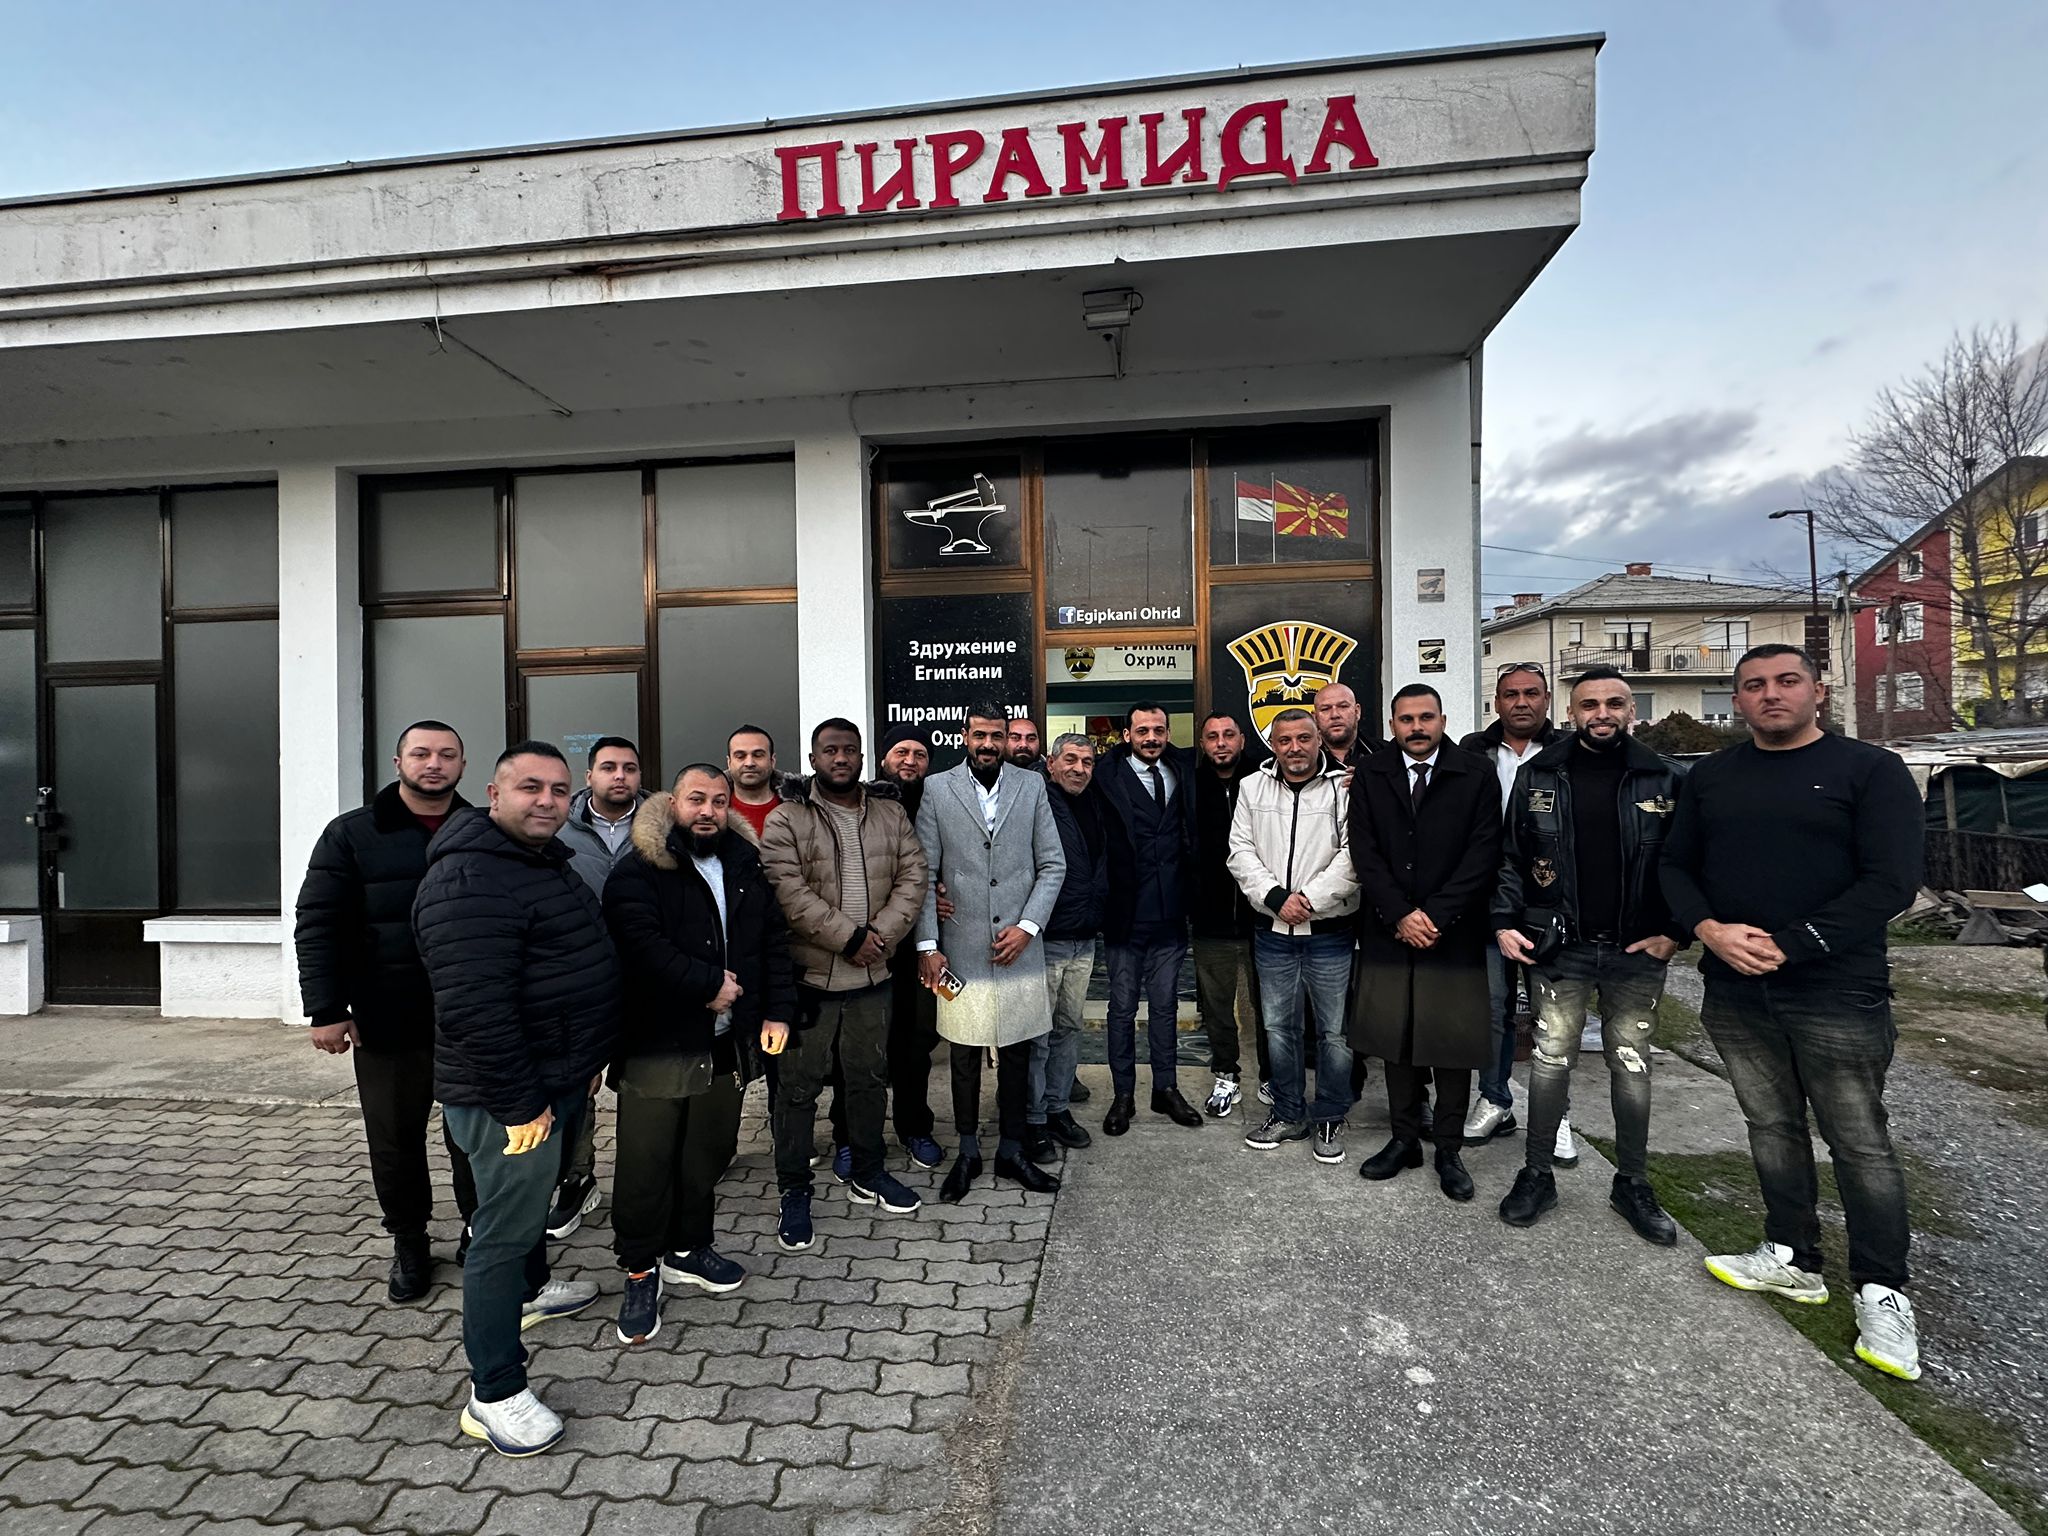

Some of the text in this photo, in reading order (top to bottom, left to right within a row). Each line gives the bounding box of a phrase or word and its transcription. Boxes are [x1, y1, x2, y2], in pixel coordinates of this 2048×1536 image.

[774, 94, 1379, 221] ПИРАМИДА
[1076, 608, 1137, 624] Egipkani
[1140, 606, 1181, 620] Ohrid
[909, 640, 1017, 660] Здружение
[1124, 653, 1176, 669] Охрид
[915, 662, 1003, 681] Египќани
[931, 731, 964, 749] Охр
